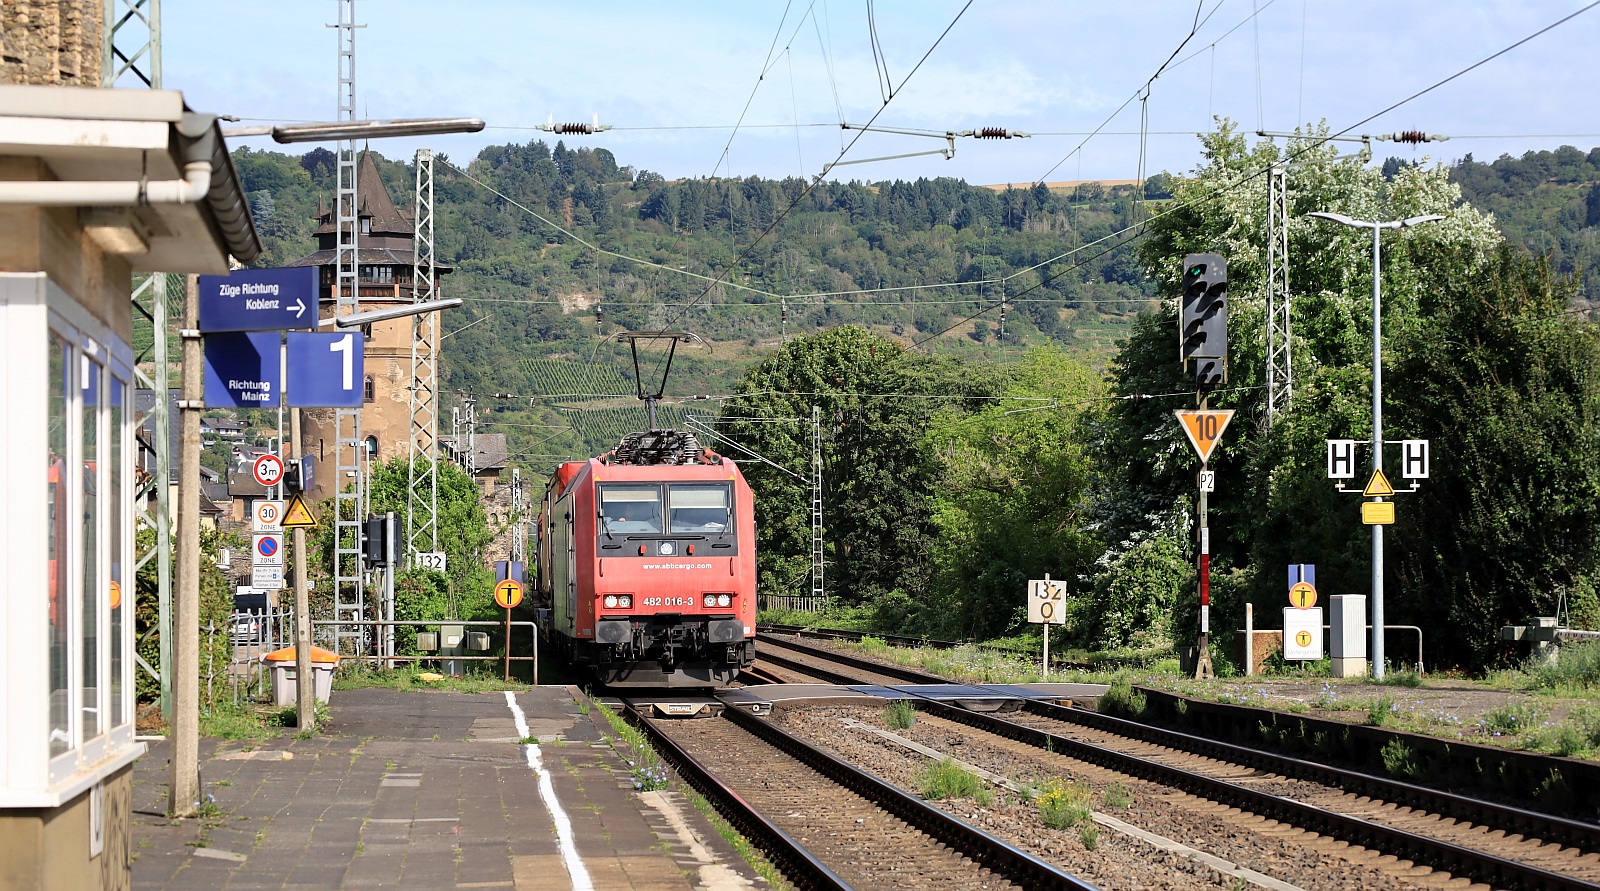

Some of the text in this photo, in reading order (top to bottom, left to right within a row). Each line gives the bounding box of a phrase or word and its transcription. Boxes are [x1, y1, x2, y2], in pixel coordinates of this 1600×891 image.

[220, 283, 279, 297] Züge Richtung
[246, 299, 279, 310] Koblenz
[330, 334, 353, 390] 1
[229, 380, 270, 391] Richtung
[242, 392, 270, 401] Mainz
[1196, 415, 1217, 440] 10
[1332, 444, 1350, 474] H
[1407, 444, 1425, 474] H
[1201, 474, 1213, 489] P2
[262, 508, 275, 518] 30
[419, 555, 442, 569] 132
[644, 597, 694, 606] 482 016-3
[1041, 602, 1053, 619] 0
